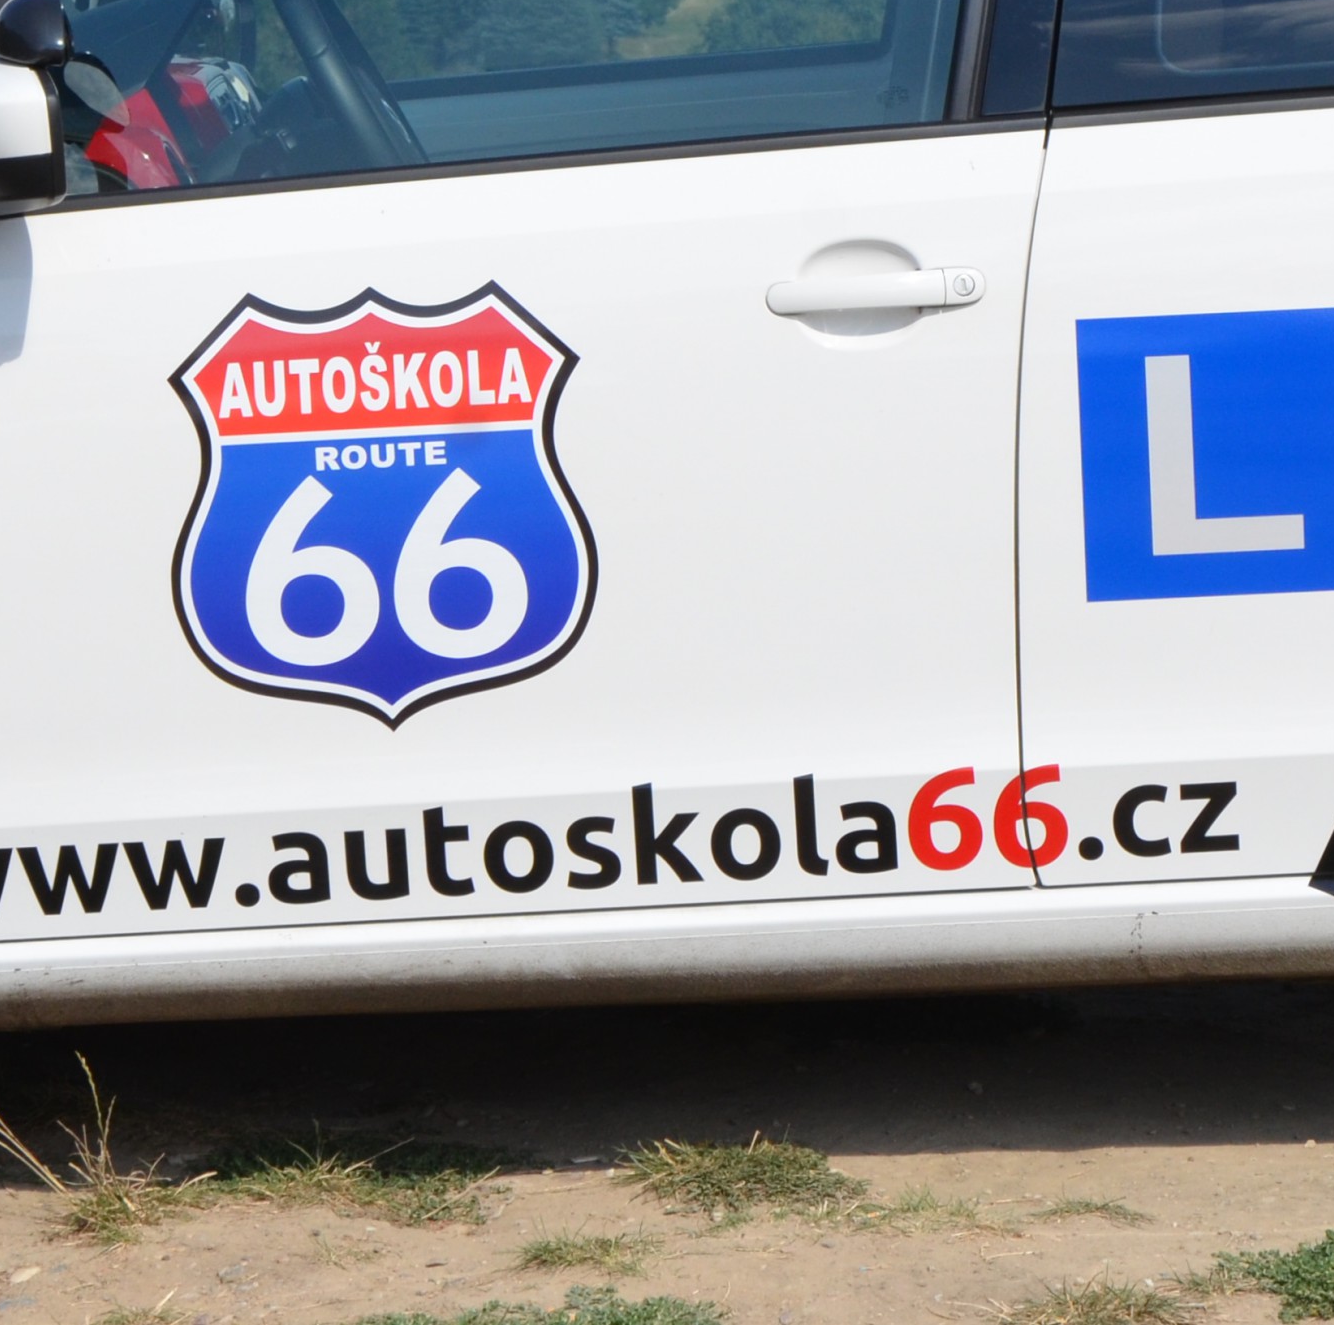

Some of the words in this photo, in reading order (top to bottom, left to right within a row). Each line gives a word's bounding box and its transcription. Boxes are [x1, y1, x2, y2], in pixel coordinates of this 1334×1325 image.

[218, 341, 532, 419] AUTOŠKOLA
[314, 440, 447, 472] ROUTE
[1144, 354, 1305, 556] L
[245, 467, 528, 667] 66
